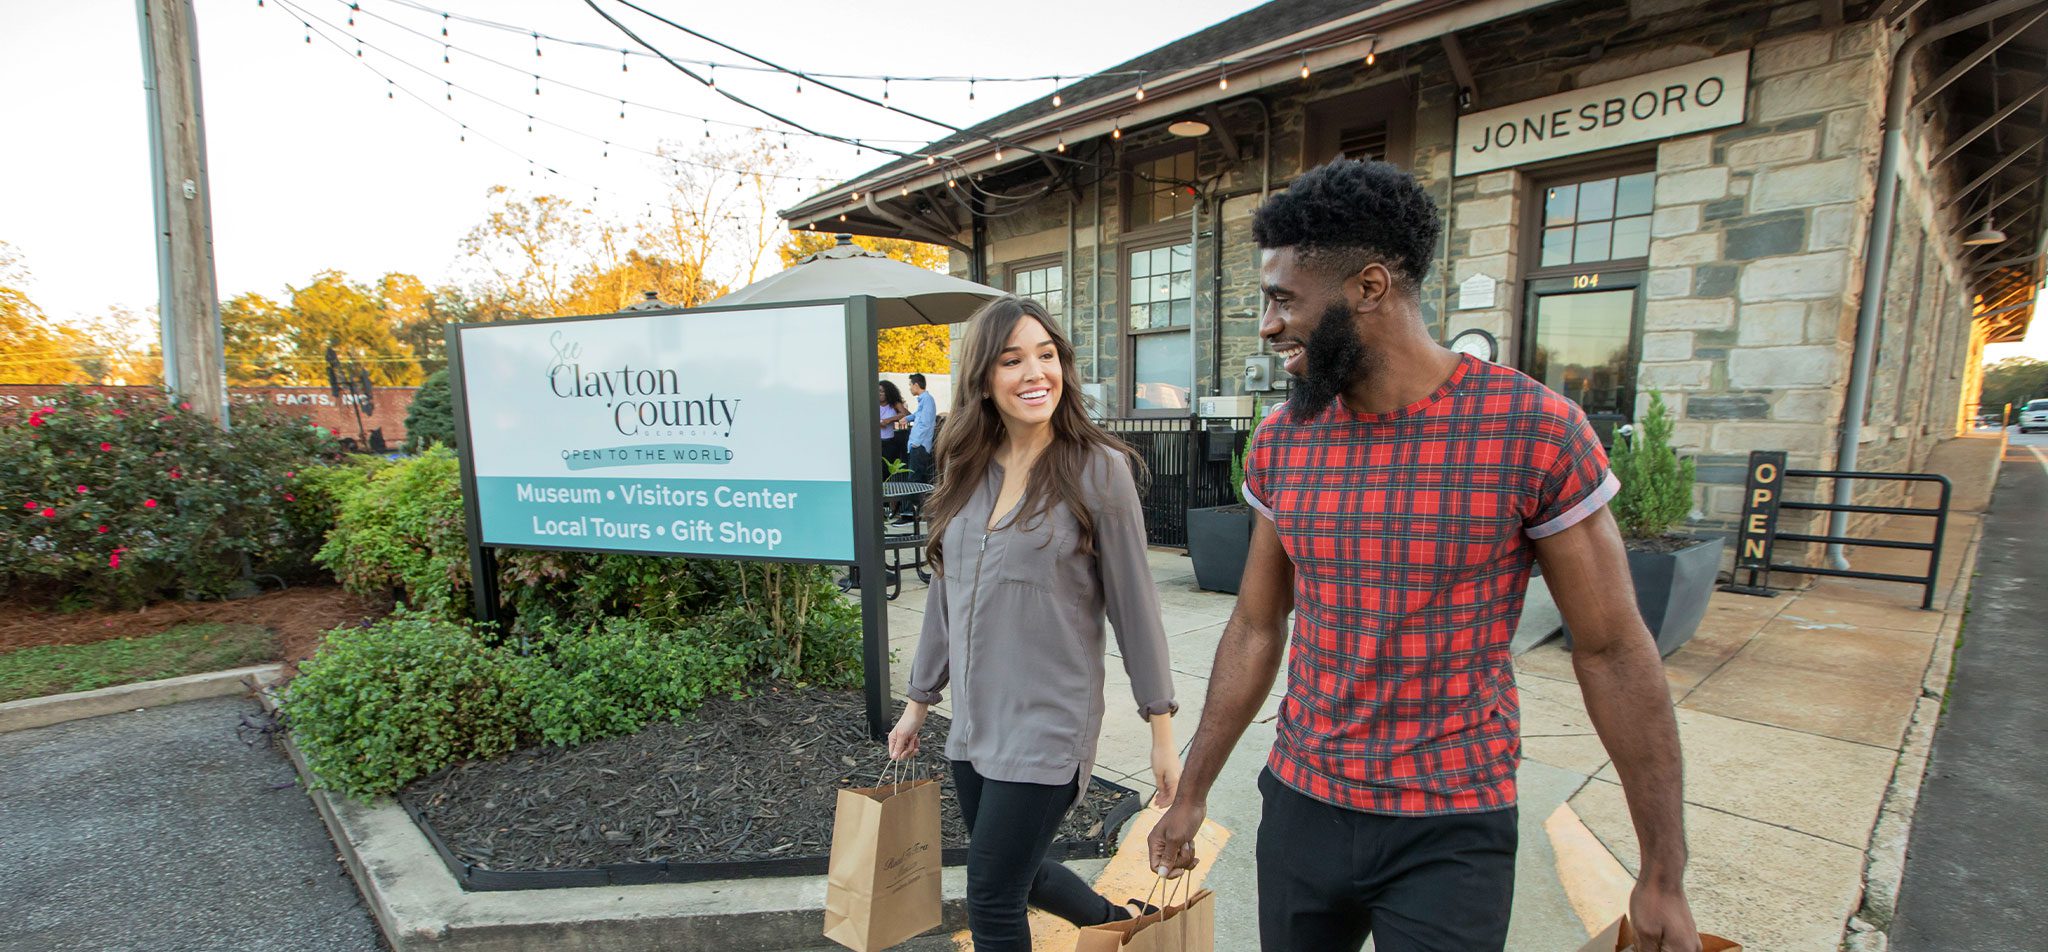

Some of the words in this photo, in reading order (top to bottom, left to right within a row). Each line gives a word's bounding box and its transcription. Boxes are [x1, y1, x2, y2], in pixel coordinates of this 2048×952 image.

[1472, 77, 1724, 153] JONESBORO
[1573, 273, 1599, 289] 104
[546, 330, 582, 378] See
[550, 363, 681, 408] Clayton
[614, 392, 741, 438] County
[561, 449, 602, 461] OPEN
[608, 449, 628, 461] TO
[634, 449, 666, 461] THE
[673, 449, 734, 461] WORLD
[516, 483, 601, 504] Museum
[619, 483, 709, 507] Visitors
[714, 486, 798, 509] Center
[1744, 463, 1777, 559] OPEN
[532, 515, 588, 536] Local
[590, 517, 651, 539] Tours
[671, 520, 714, 543] Gift
[719, 521, 782, 550] Shop
